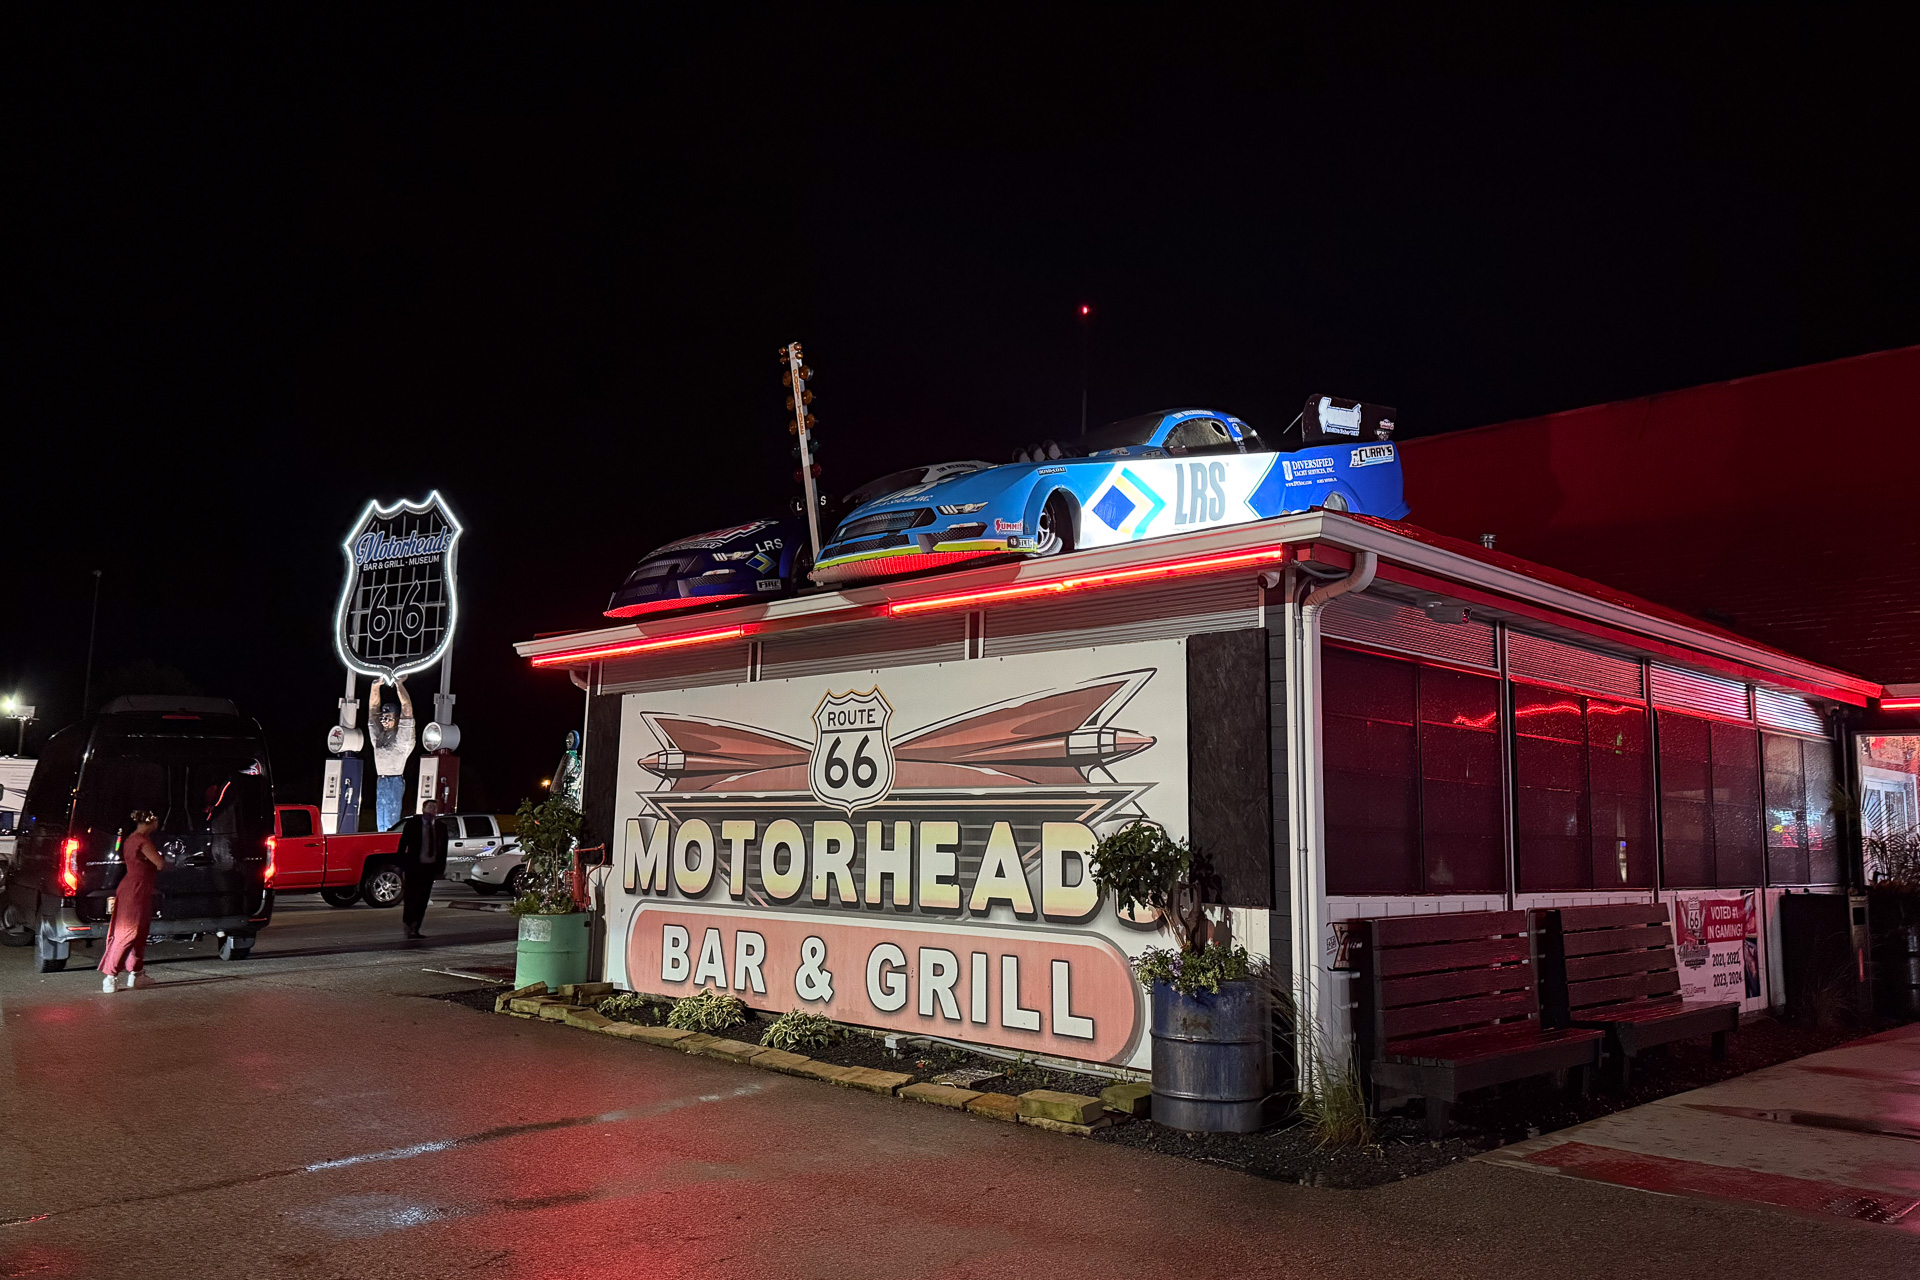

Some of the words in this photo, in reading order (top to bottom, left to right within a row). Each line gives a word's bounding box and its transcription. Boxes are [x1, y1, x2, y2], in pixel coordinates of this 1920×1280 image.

[1292, 458, 1334, 470] DIVERSIFIED
[1174, 461, 1226, 525] LRS
[355, 526, 452, 566] Motorheads
[755, 538, 783, 553] LRS
[363, 562, 378, 571] BAR
[378, 561, 383, 570] &
[384, 558, 405, 569] GRILL
[408, 554, 440, 566] MUSEUM
[367, 579, 426, 642] 66
[827, 708, 876, 727] ROUTE
[824, 734, 878, 789] 66
[1710, 906, 1732, 920] VOTED
[1707, 925, 1716, 939] IN
[1715, 924, 1743, 938] GAMING!
[1712, 953, 1726, 968] 2021,
[661, 923, 767, 995] BAR
[795, 936, 834, 1003] &
[866, 943, 1095, 1041] GRILL
[1713, 973, 1728, 987] 2023,
